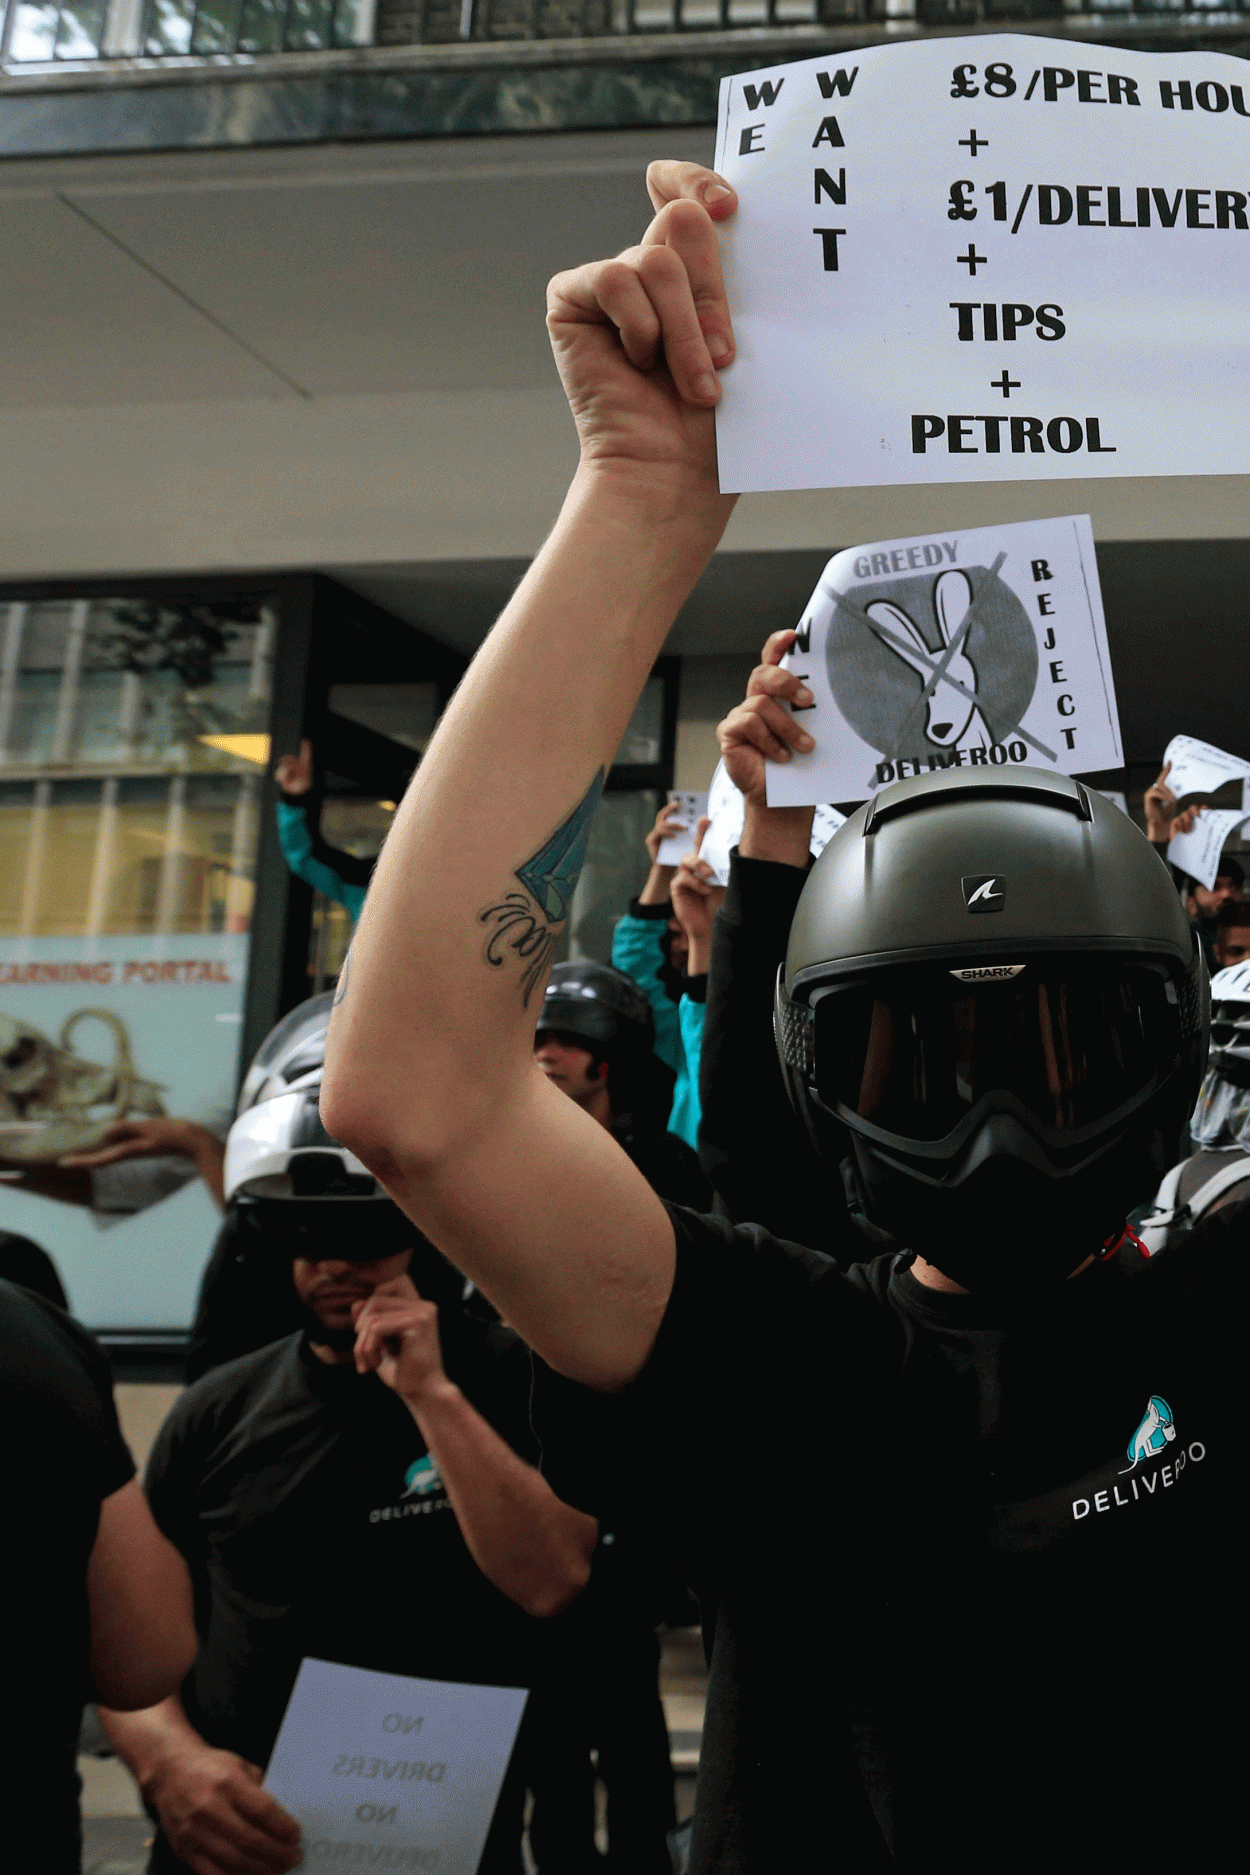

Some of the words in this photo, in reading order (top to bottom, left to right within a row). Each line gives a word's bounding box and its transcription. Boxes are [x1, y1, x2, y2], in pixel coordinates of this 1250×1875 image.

[950, 62, 1141, 106] £8/PER
[958, 129, 989, 157] +
[812, 67, 859, 271] WANT
[956, 243, 988, 276] +
[949, 302, 1066, 342] TIPS
[990, 369, 1022, 399] +
[911, 414, 1117, 454] PETROL
[854, 539, 959, 579] GREEDY
[1031, 559, 1077, 750] REJECT
[0, 961, 113, 984] ARNING
[124, 960, 231, 983] PORTAL
[960, 966, 1014, 979] SHARK
[1072, 1441, 1206, 1520] DELIVEROO
